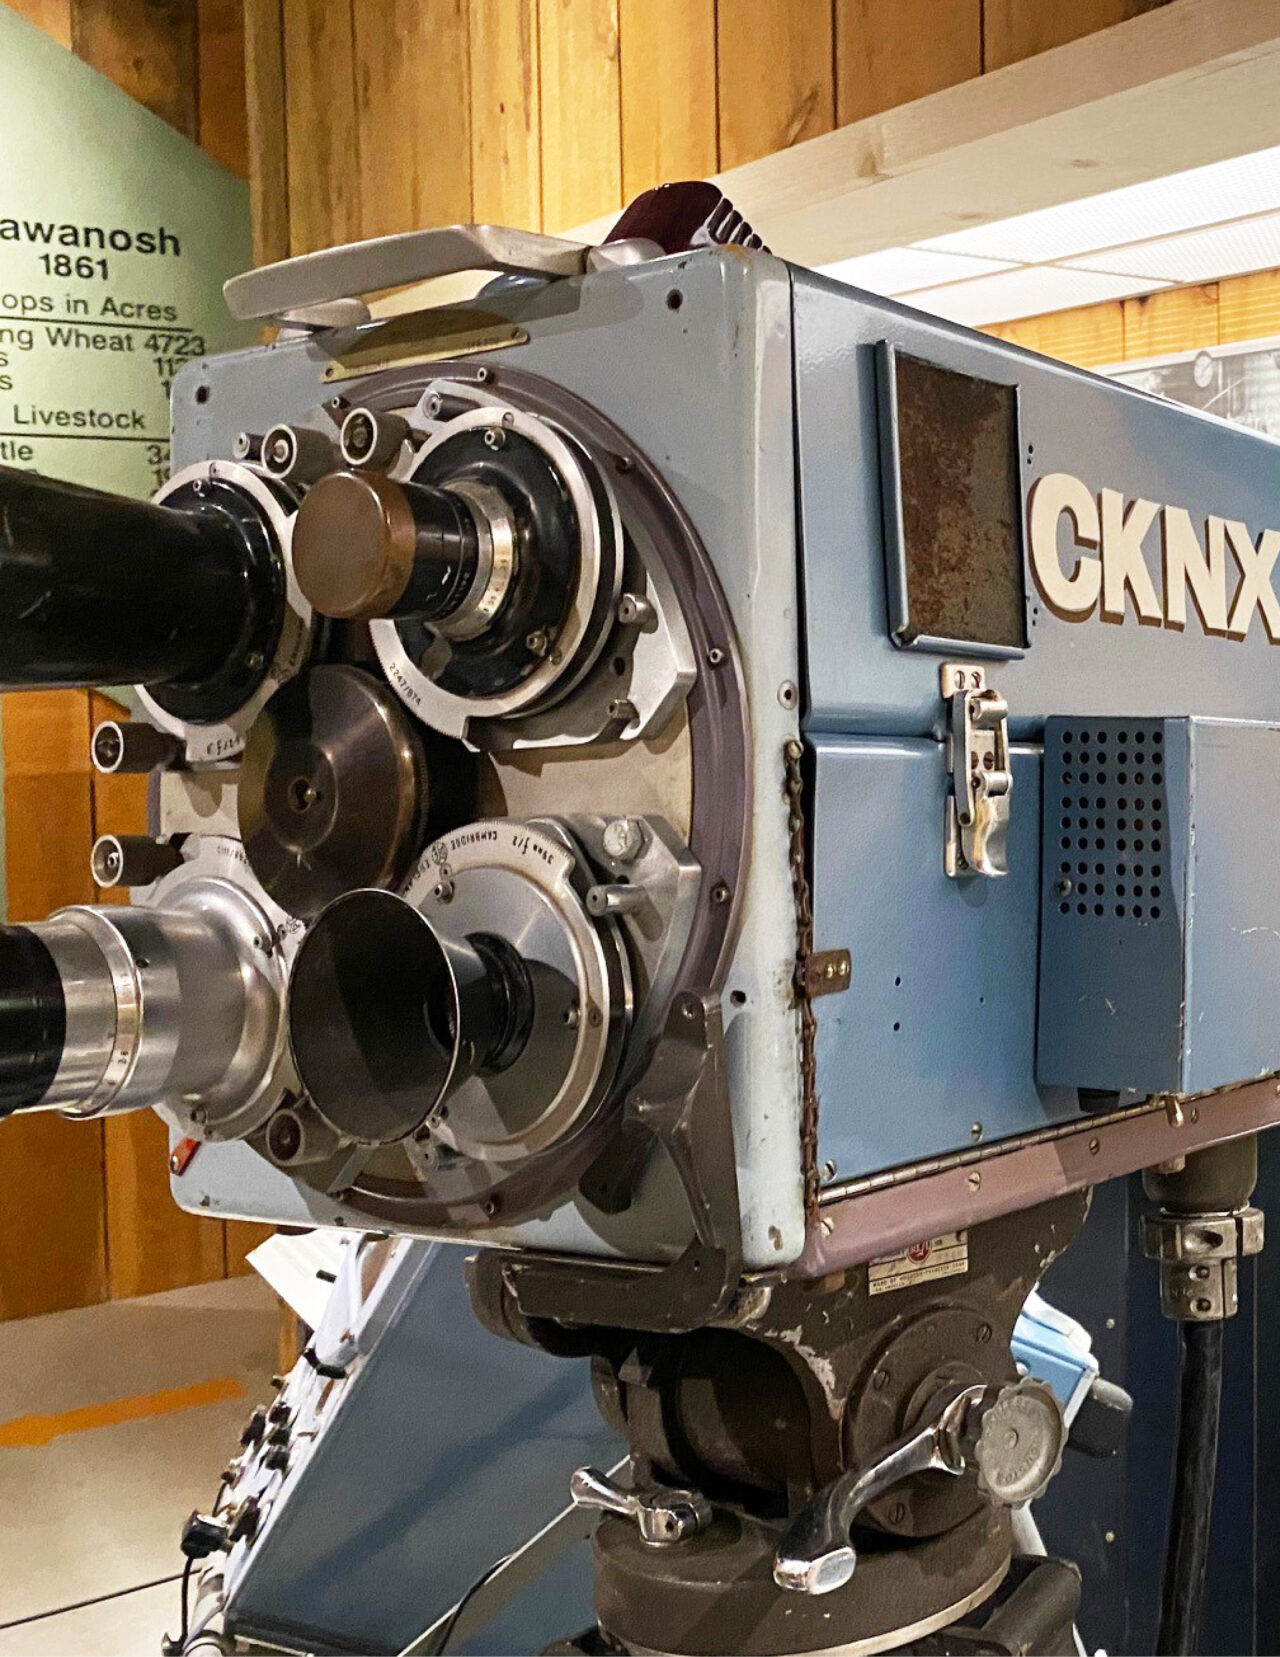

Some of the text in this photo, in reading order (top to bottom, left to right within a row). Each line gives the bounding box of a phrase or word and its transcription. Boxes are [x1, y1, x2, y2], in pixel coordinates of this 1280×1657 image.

[39, 253, 109, 281] 1861
[66, 293, 89, 315] in
[100, 297, 178, 322] Acres
[45, 327, 134, 352] Wheat
[144, 333, 206, 356] 4723
[153, 357, 187, 377] 11
[13, 404, 146, 429] Livestock
